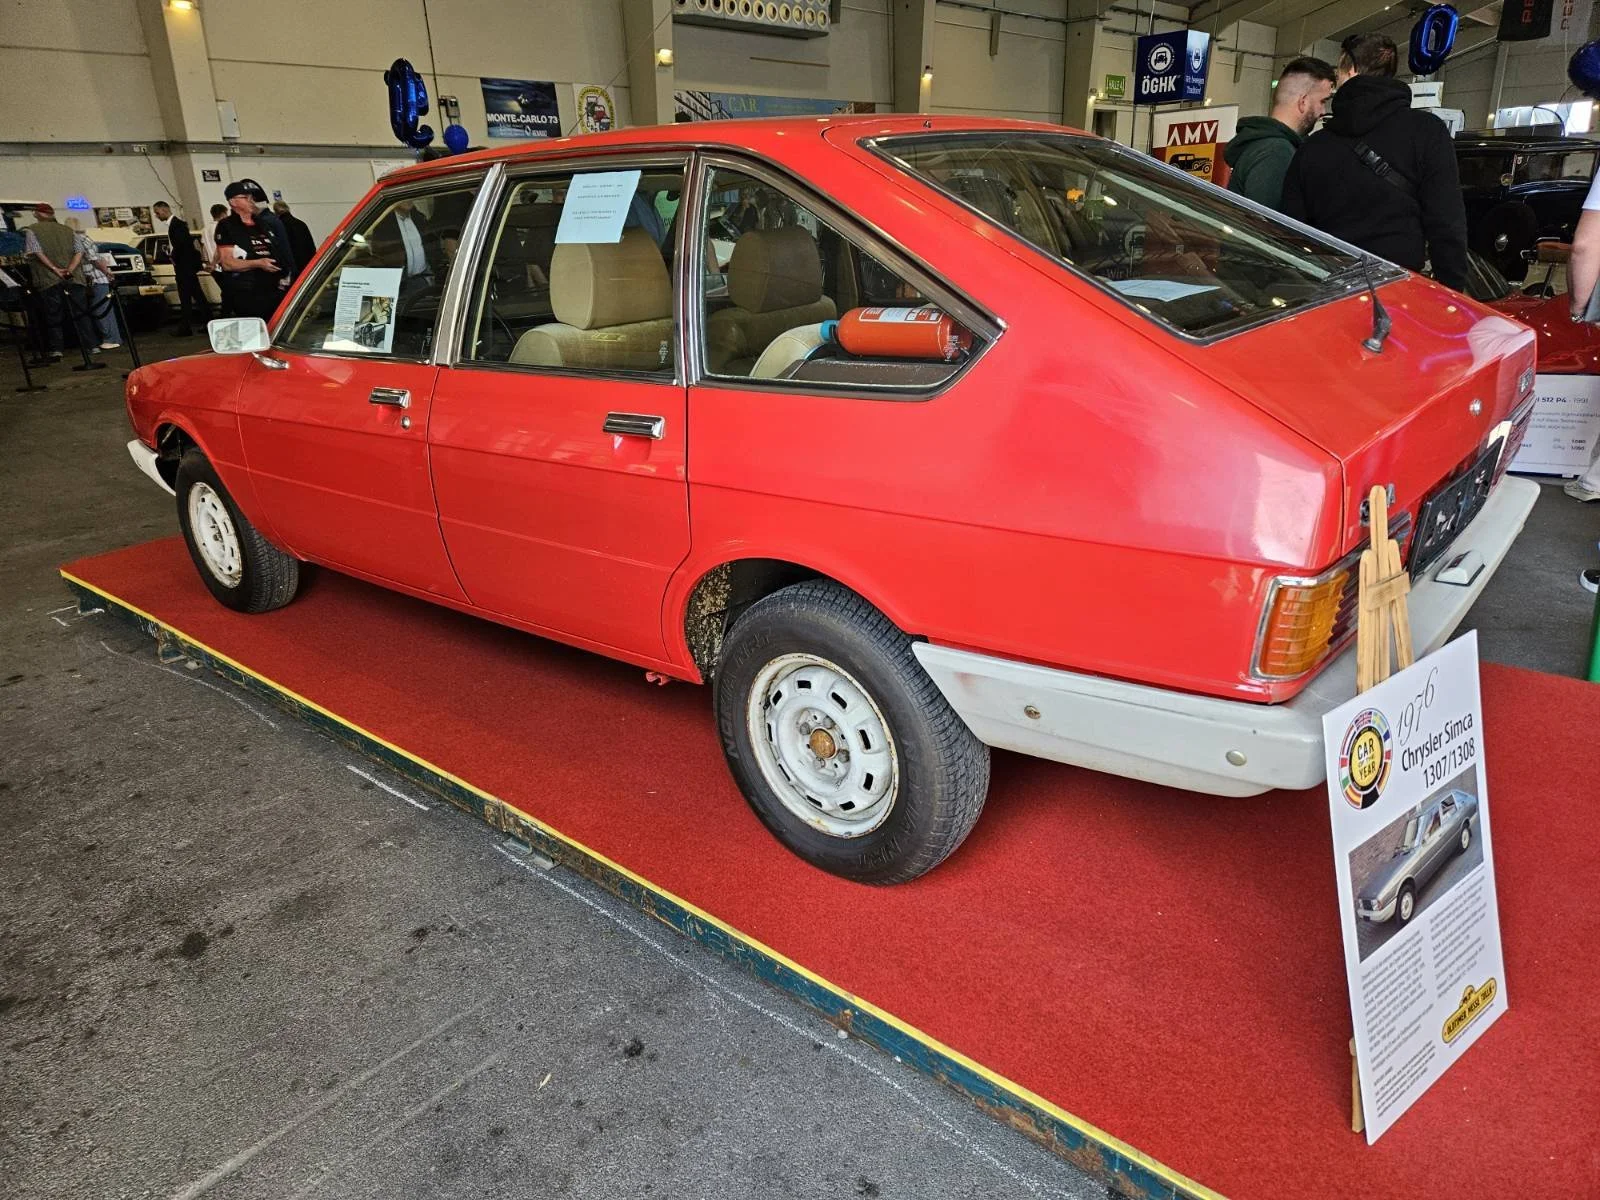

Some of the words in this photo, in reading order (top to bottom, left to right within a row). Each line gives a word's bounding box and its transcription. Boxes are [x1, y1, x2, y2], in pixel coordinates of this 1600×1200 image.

[1141, 75, 1177, 95] ÖGHK
[486, 113, 547, 124] MONTE-CARLO
[548, 115, 558, 124] 73
[1168, 123, 1217, 145] AMV
[1397, 666, 1438, 746] 1976
[1357, 738, 1374, 761] CAR
[1401, 730, 1443, 772] Chrysler
[1444, 713, 1473, 745] Simca
[1359, 761, 1376, 780] YEAR
[1423, 737, 1476, 789] 1307/1308
